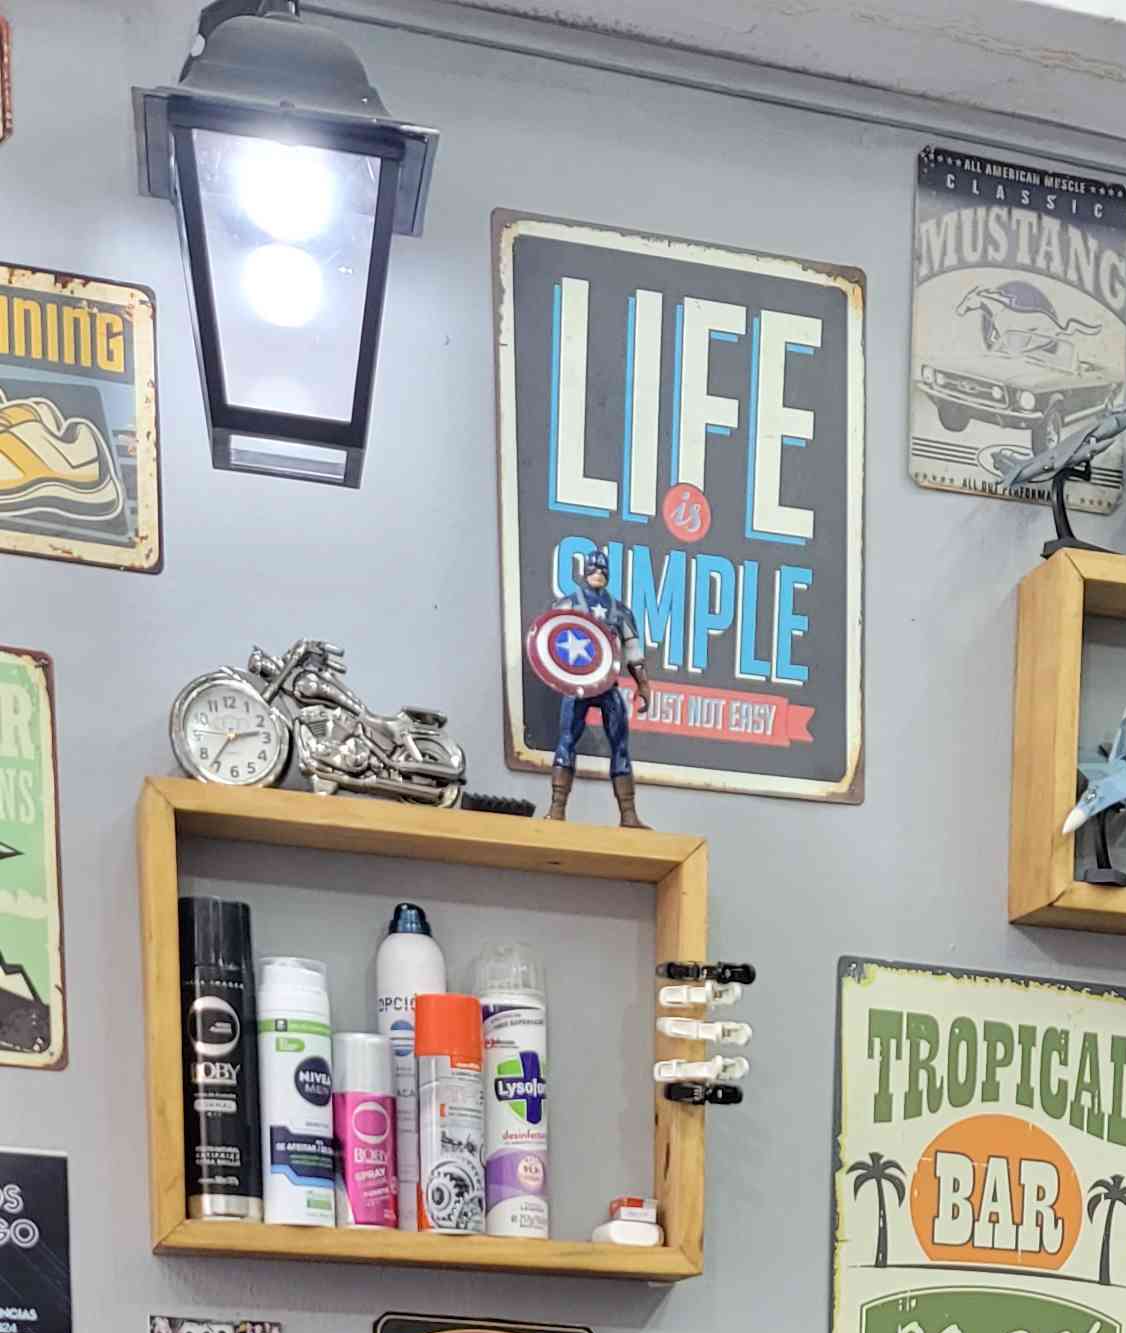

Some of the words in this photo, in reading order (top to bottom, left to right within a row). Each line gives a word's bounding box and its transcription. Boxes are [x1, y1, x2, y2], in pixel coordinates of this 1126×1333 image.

[963, 159, 981, 173] ALL
[985, 166, 1040, 185] AMERICAN
[1044, 174, 1085, 194] MUSCLE
[946, 173, 1103, 219] CLASSIC
[916, 206, 1126, 311] MUSTANG
[548, 277, 823, 546] LIFE
[671, 492, 702, 533] is
[223, 697, 236, 709] 12
[256, 715, 264, 727] 2
[688, 695, 727, 729] NOT
[728, 700, 777, 736] EASY
[262, 732, 271, 744] 3
[200, 747, 208, 760] 8
[258, 750, 267, 760] 4
[230, 766, 239, 778] 6
[247, 762, 256, 774] 5
[299, 1070, 331, 1086] NIVEA
[0, 1184, 24, 1213] S
[932, 1149, 1064, 1255] BAR
